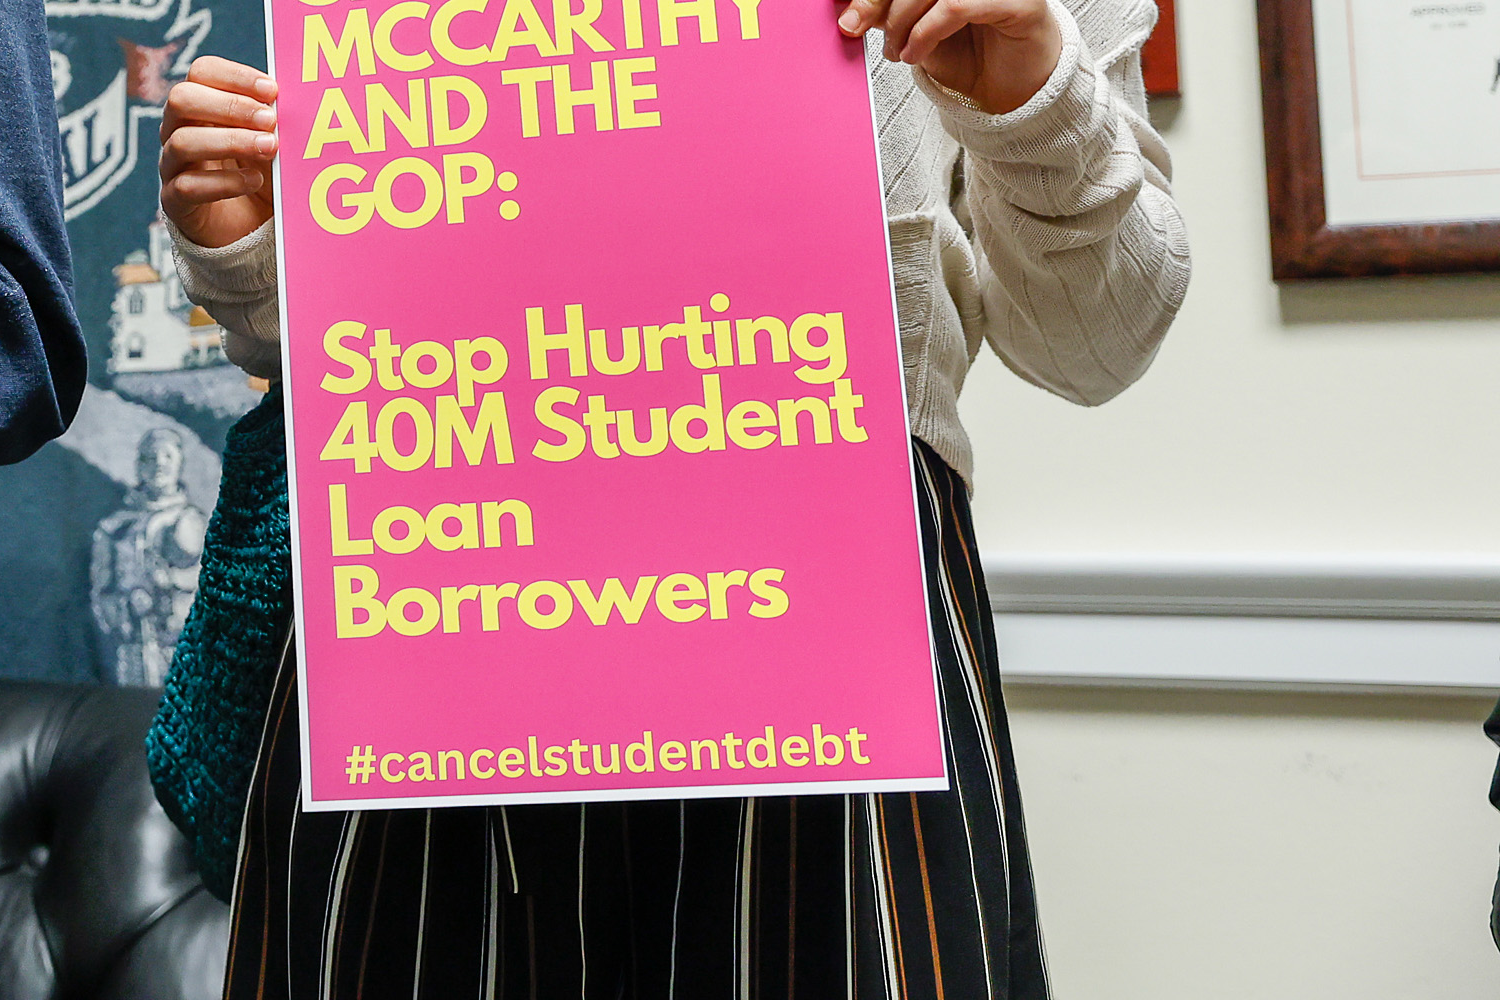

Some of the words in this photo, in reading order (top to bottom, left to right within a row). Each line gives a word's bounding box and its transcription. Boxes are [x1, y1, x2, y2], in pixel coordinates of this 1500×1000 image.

[303, 75, 488, 159] AND
[502, 56, 662, 138] THE
[308, 152, 522, 235] GOP:
[321, 320, 509, 407] Stop
[526, 293, 848, 384] Hurting
[319, 394, 516, 474] 40M
[532, 373, 869, 462] Student
[328, 484, 534, 557] Loan
[333, 565, 790, 639] Borrowers
[345, 724, 871, 785] #cancelstudentdebt
